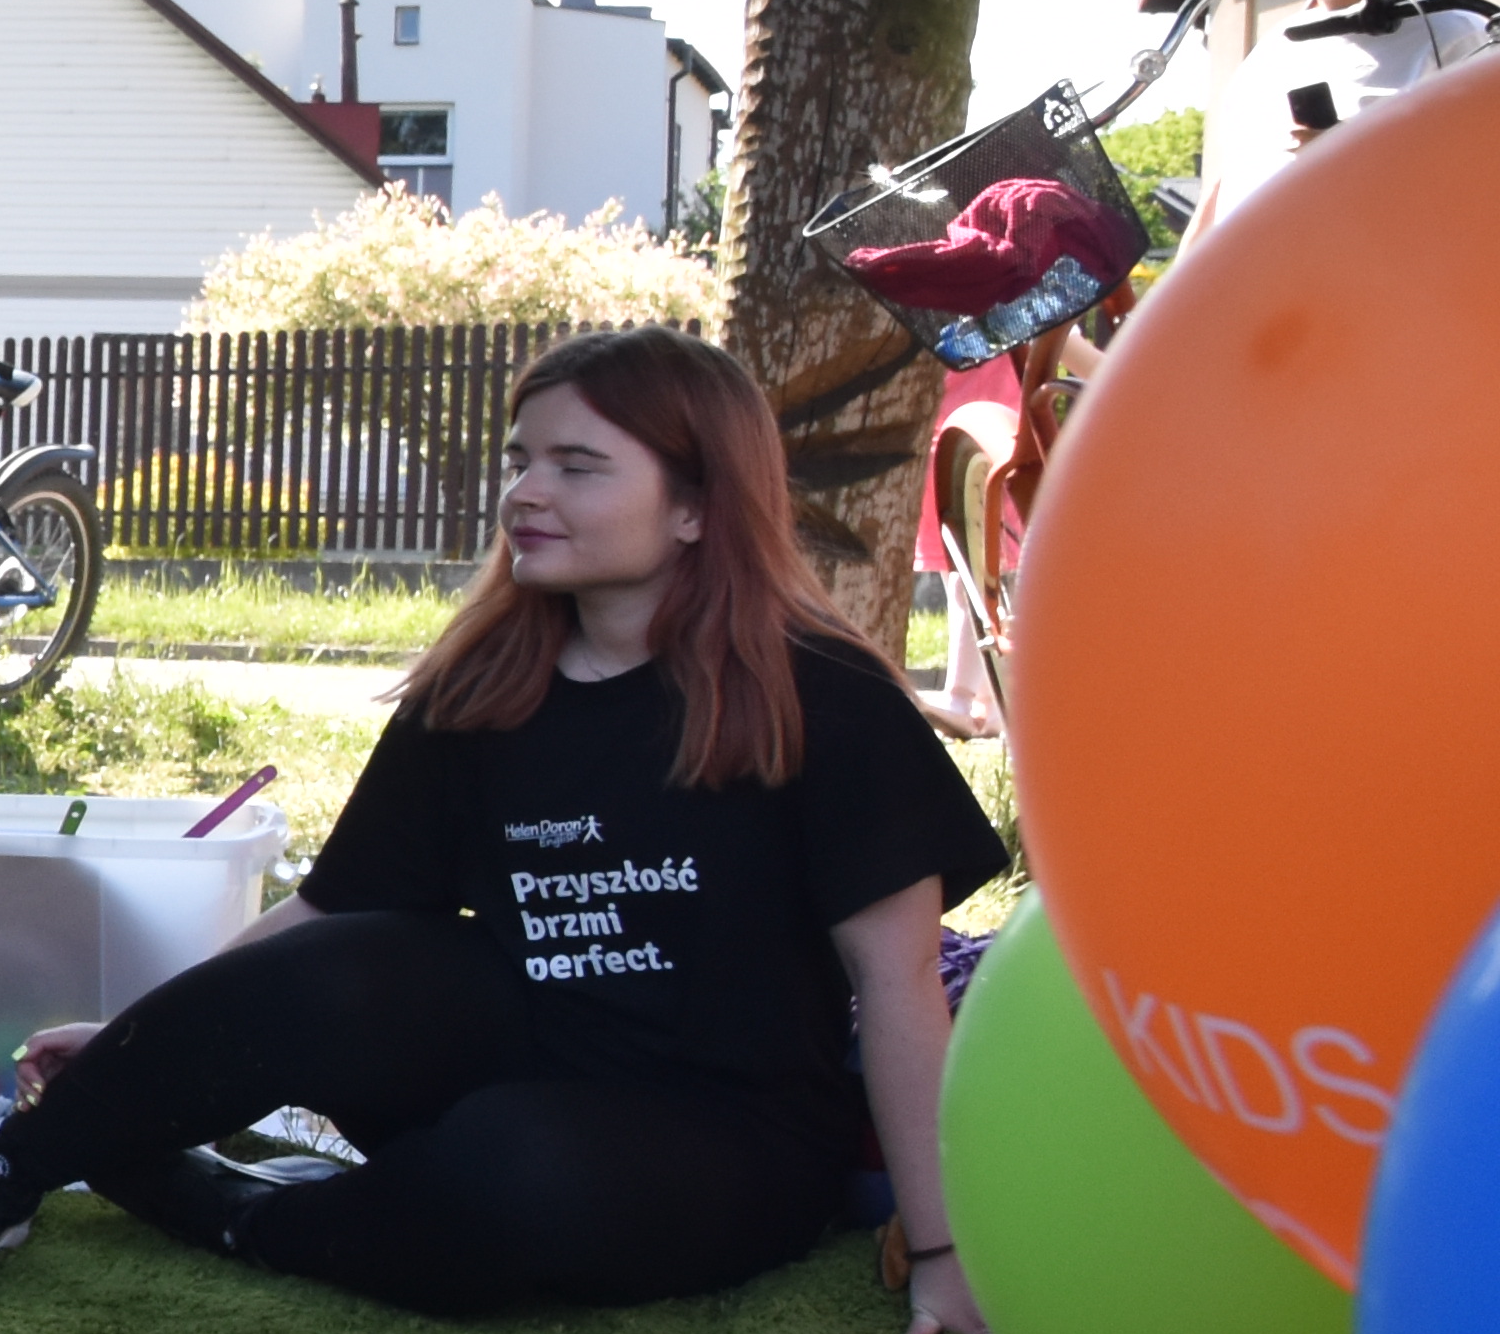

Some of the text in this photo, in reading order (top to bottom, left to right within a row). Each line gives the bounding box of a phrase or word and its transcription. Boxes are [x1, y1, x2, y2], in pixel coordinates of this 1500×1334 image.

[504, 818, 582, 840] Helen Doron
[539, 830, 580, 849] English
[510, 856, 699, 904] Przyszłość
[520, 902, 624, 941] brzmi
[525, 941, 674, 982] perfect.
[1103, 969, 1398, 1147] KIDS
